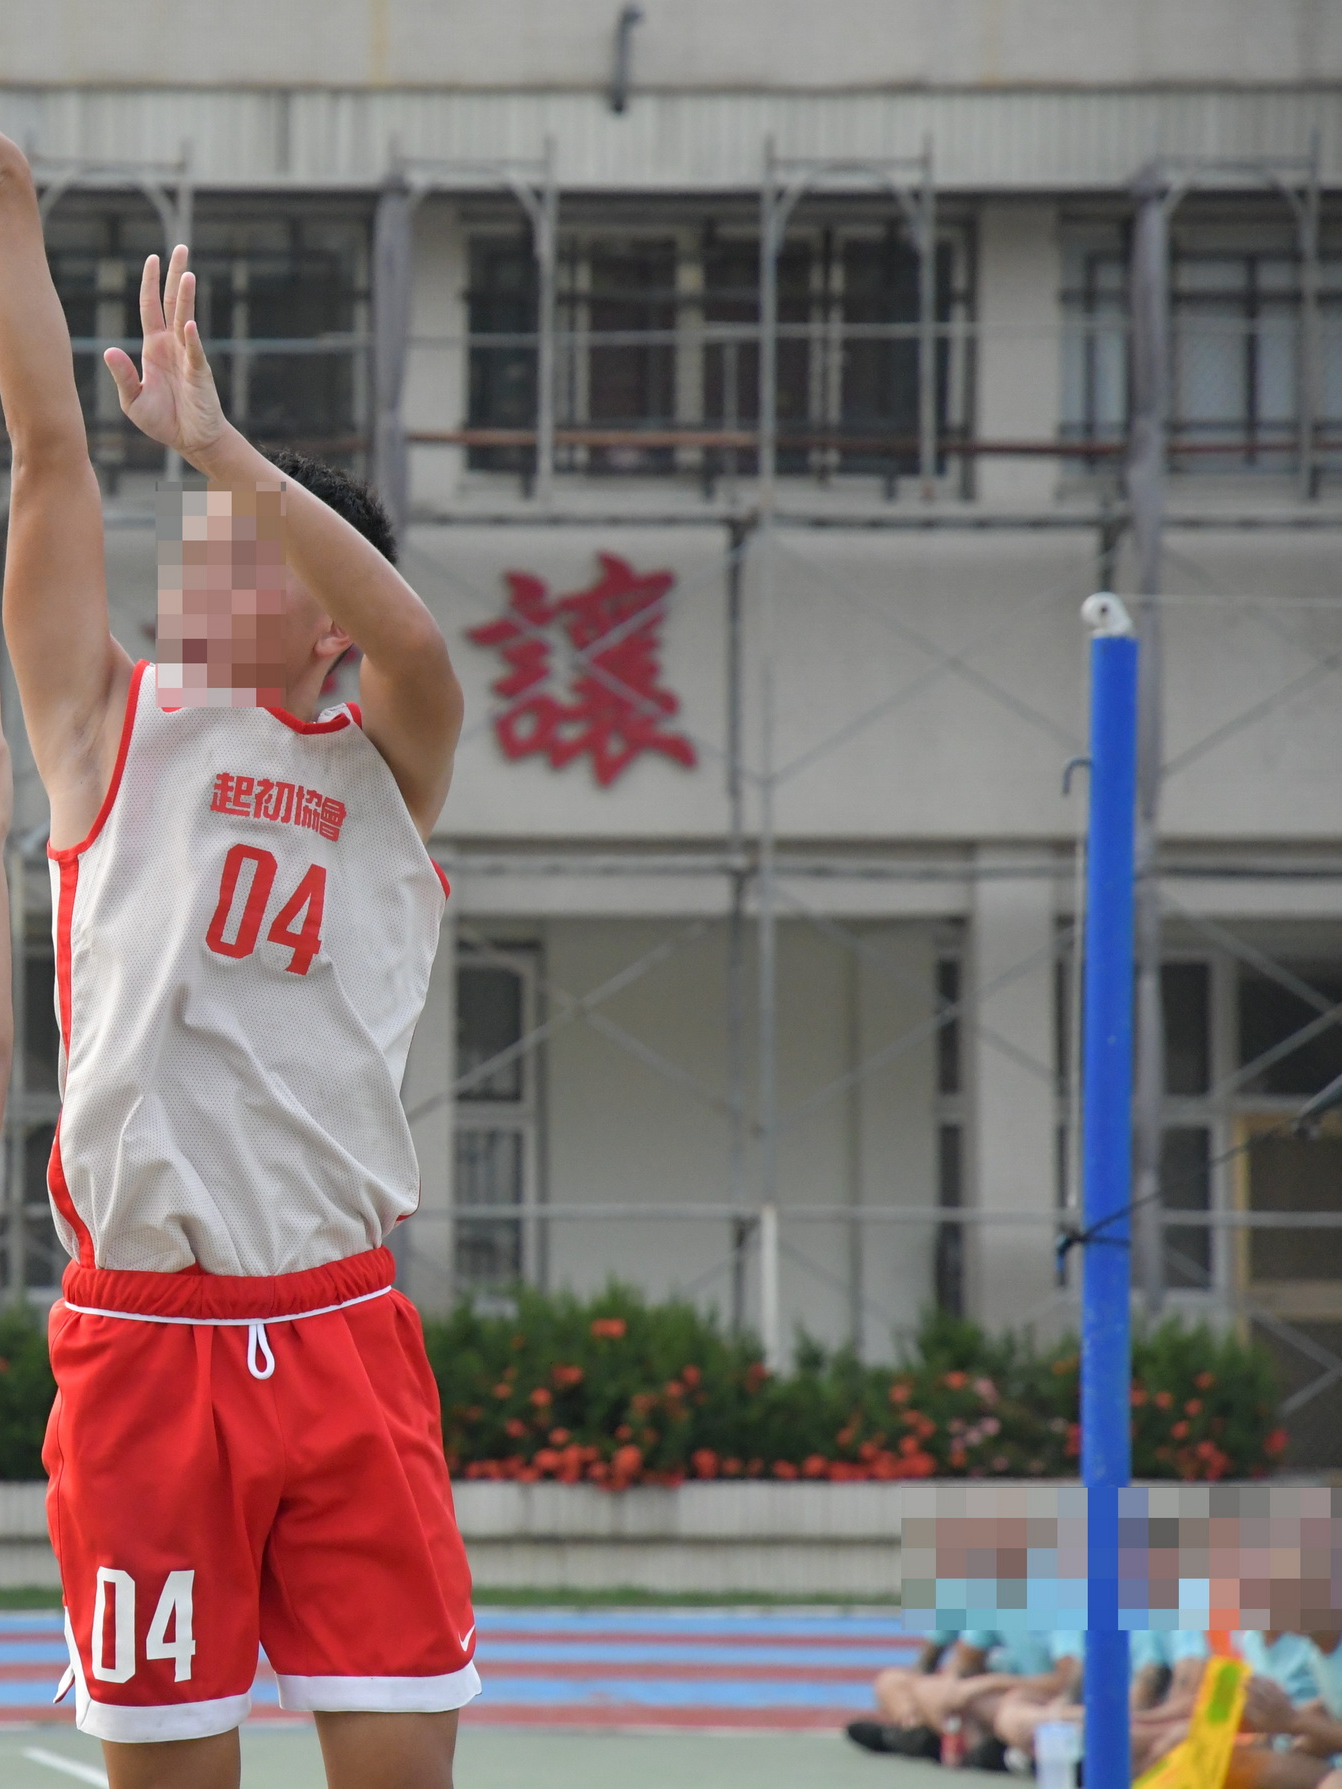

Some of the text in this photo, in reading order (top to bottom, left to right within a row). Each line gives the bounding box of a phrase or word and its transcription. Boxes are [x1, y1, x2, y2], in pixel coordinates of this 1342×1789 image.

[210, 772, 347, 842] 起初協會
[205, 843, 327, 976] 04
[91, 1566, 196, 1684] 04
